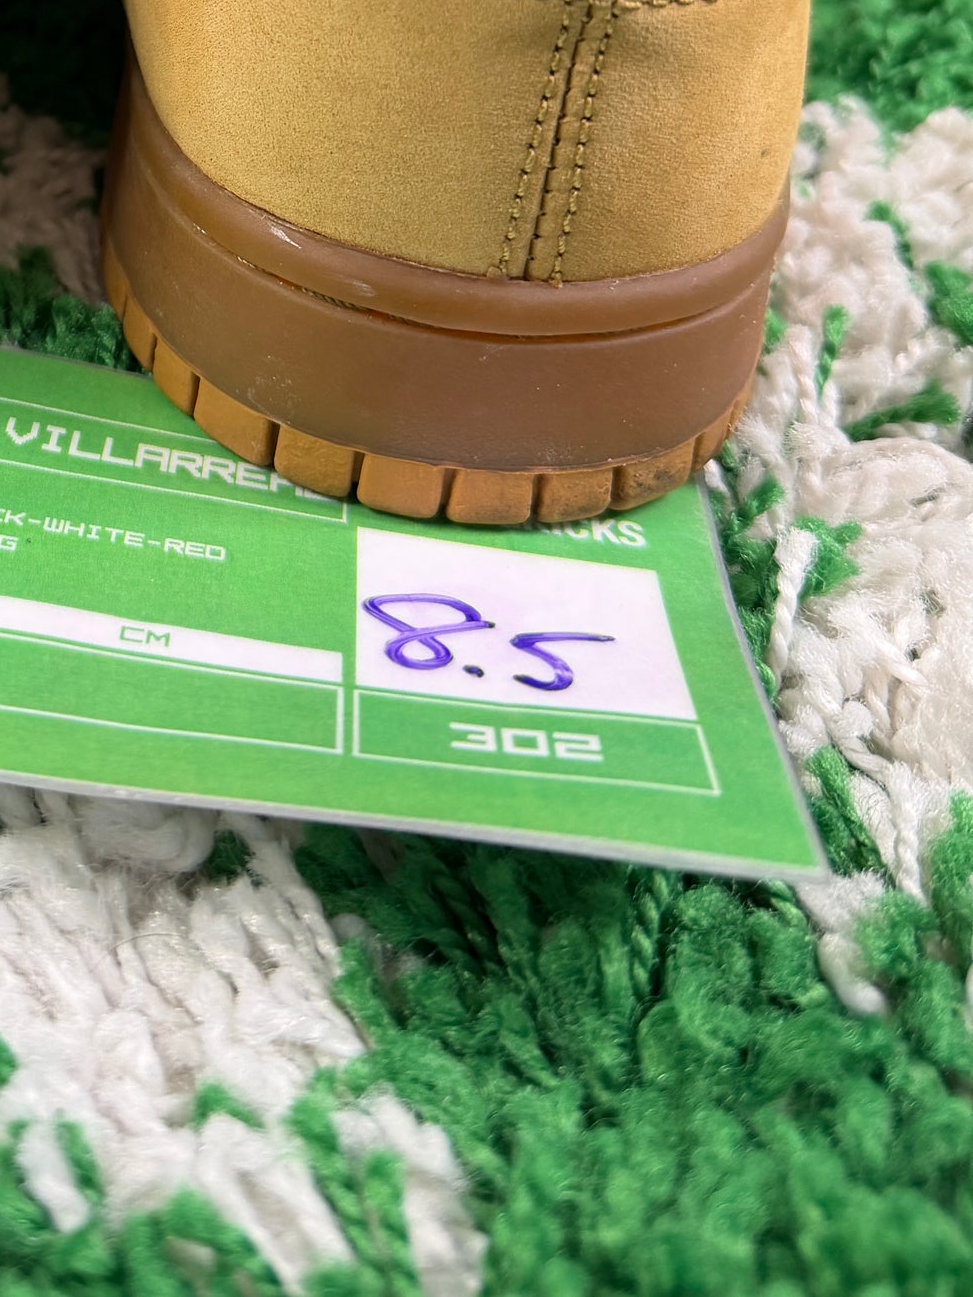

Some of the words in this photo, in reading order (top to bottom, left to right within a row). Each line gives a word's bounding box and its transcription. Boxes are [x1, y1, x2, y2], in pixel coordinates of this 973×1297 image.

[5, 415, 343, 503] VILLARRE
[524, 517, 650, 547] CKS
[119, 626, 171, 648] CM
[363, 592, 616, 692] 8.5
[449, 721, 604, 762] 302
